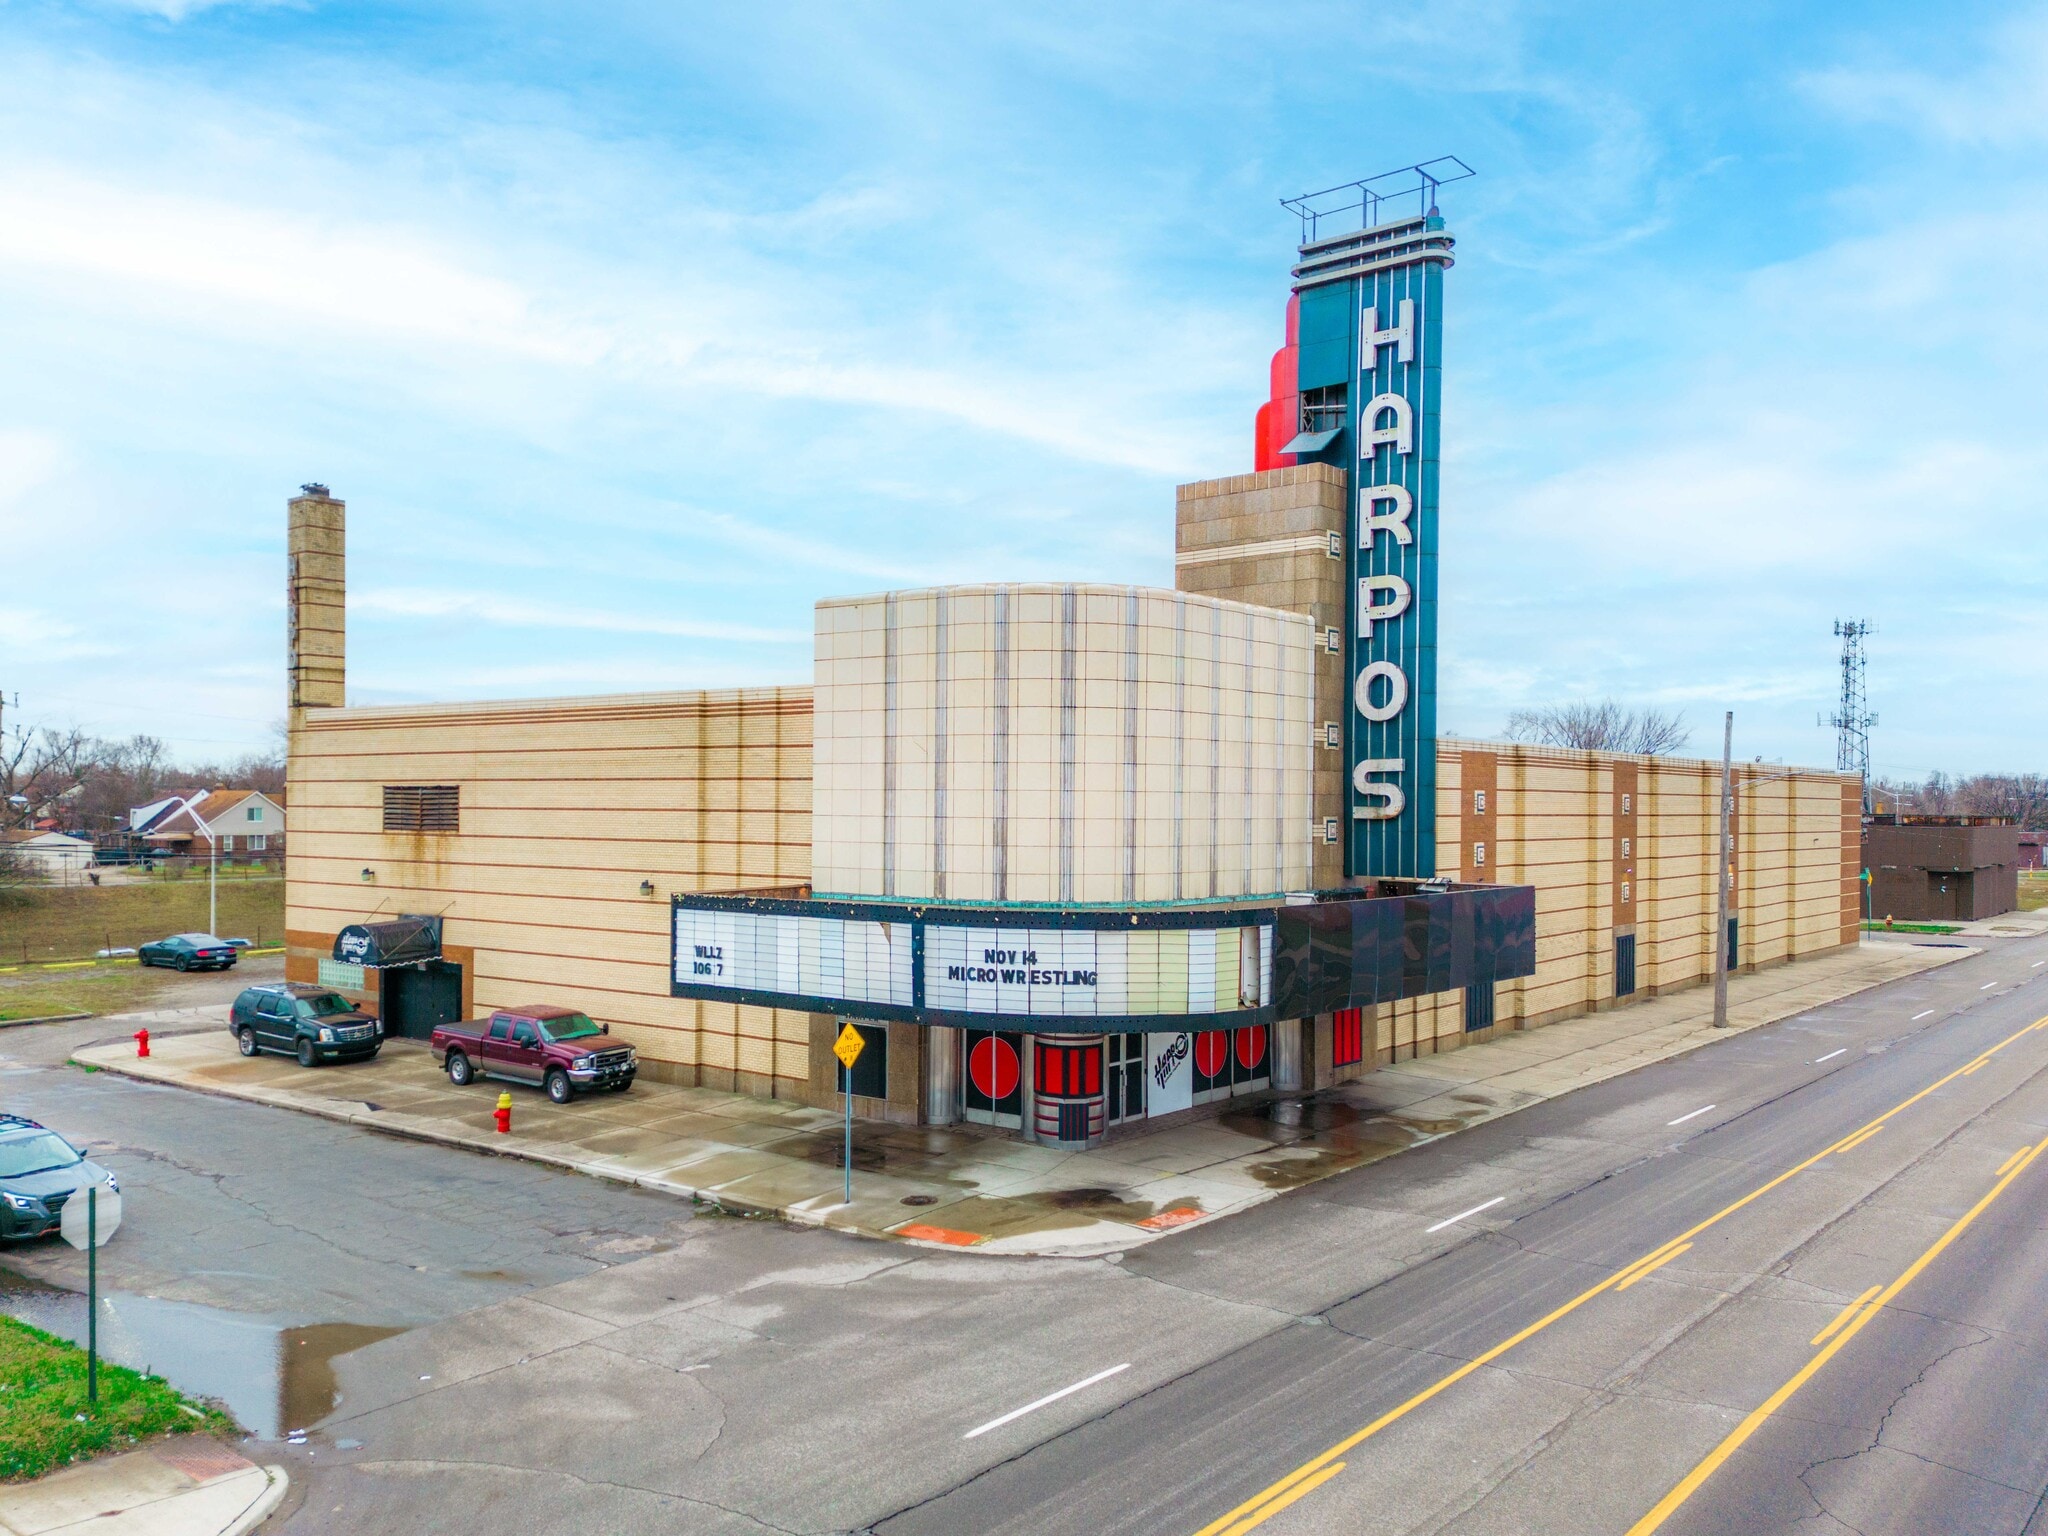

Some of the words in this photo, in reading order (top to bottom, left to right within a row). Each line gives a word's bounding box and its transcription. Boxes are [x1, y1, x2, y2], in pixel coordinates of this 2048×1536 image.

[1352, 298, 1414, 820] HARPOS
[694, 945, 723, 960] WLLZ
[984, 949, 1016, 964] NOV
[1022, 950, 1038, 965] 14
[693, 961, 712, 975] 106
[948, 966, 997, 983] MICRO
[1000, 968, 1098, 986] WRESTLING
[844, 1033, 854, 1041] NO
[838, 1043, 861, 1054] OUTLET
